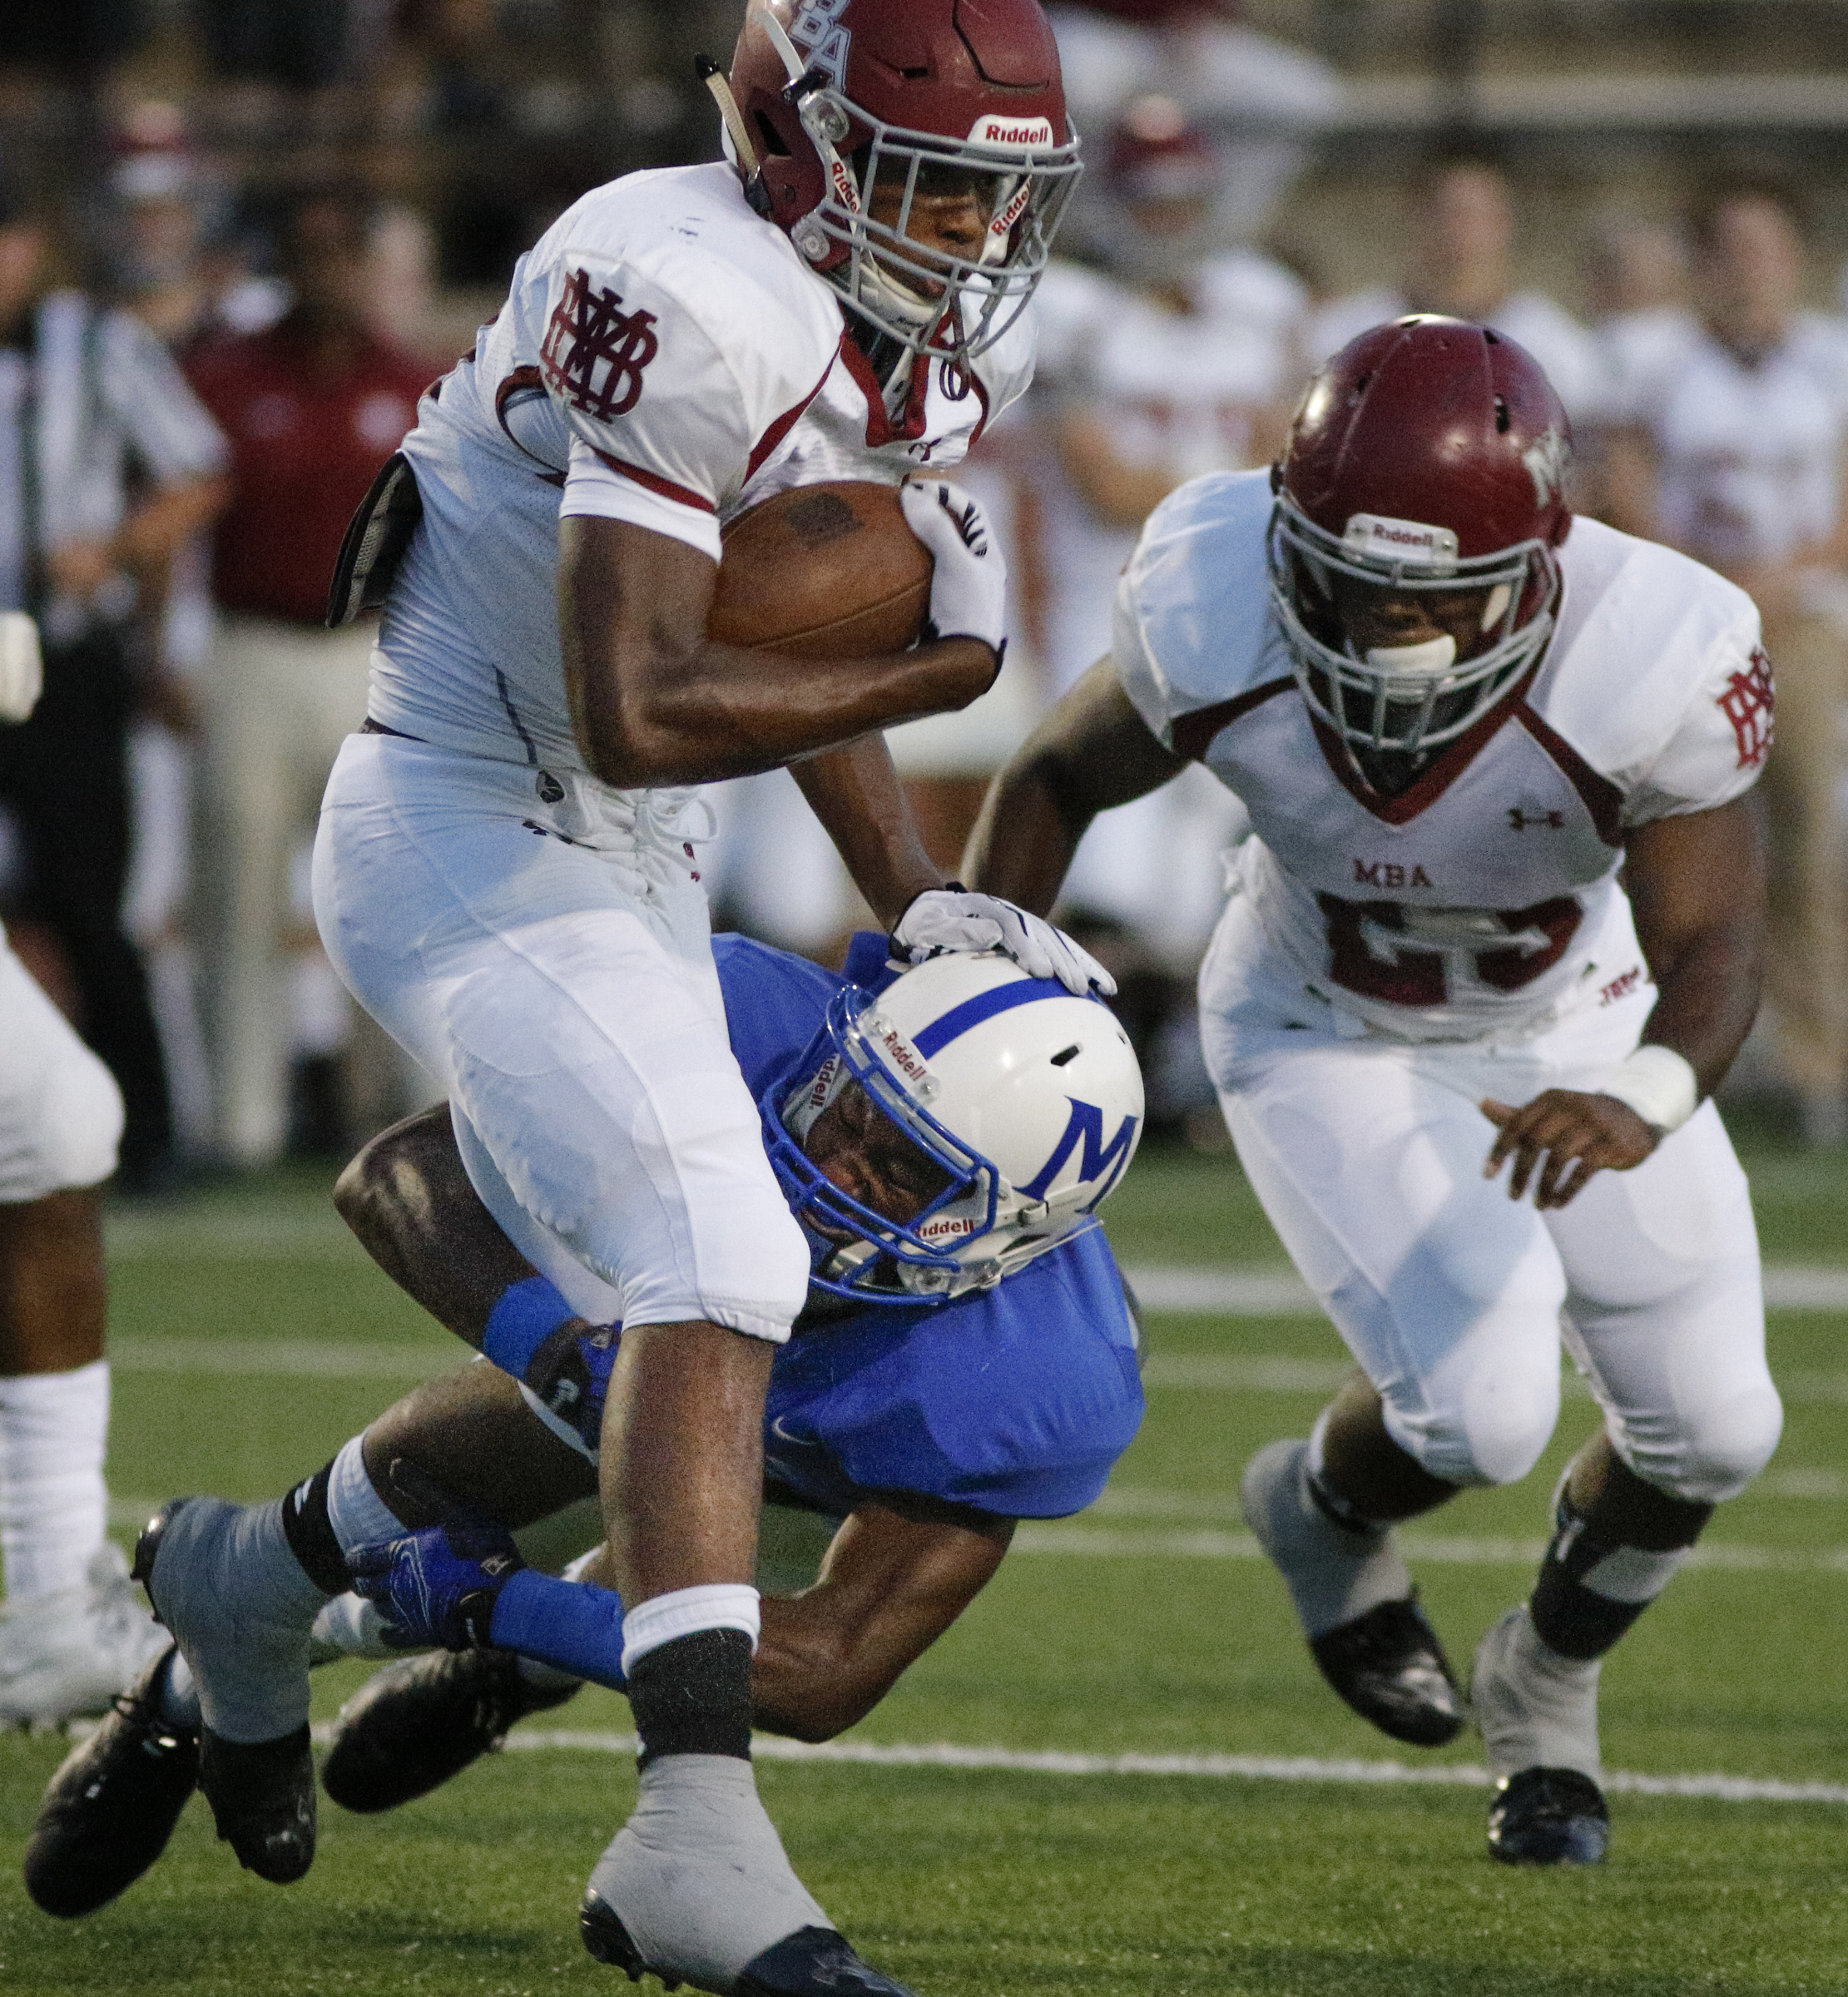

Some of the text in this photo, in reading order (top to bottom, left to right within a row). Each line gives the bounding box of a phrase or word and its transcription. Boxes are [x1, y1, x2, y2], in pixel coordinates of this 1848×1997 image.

[985, 124, 1049, 143] Riddell
[1374, 523, 1434, 547] Riddell
[1353, 858, 1434, 888] MBA
[883, 1030, 927, 1082] Riddell
[810, 1058, 835, 1108] ddell
[1012, 1094, 1140, 1216] M
